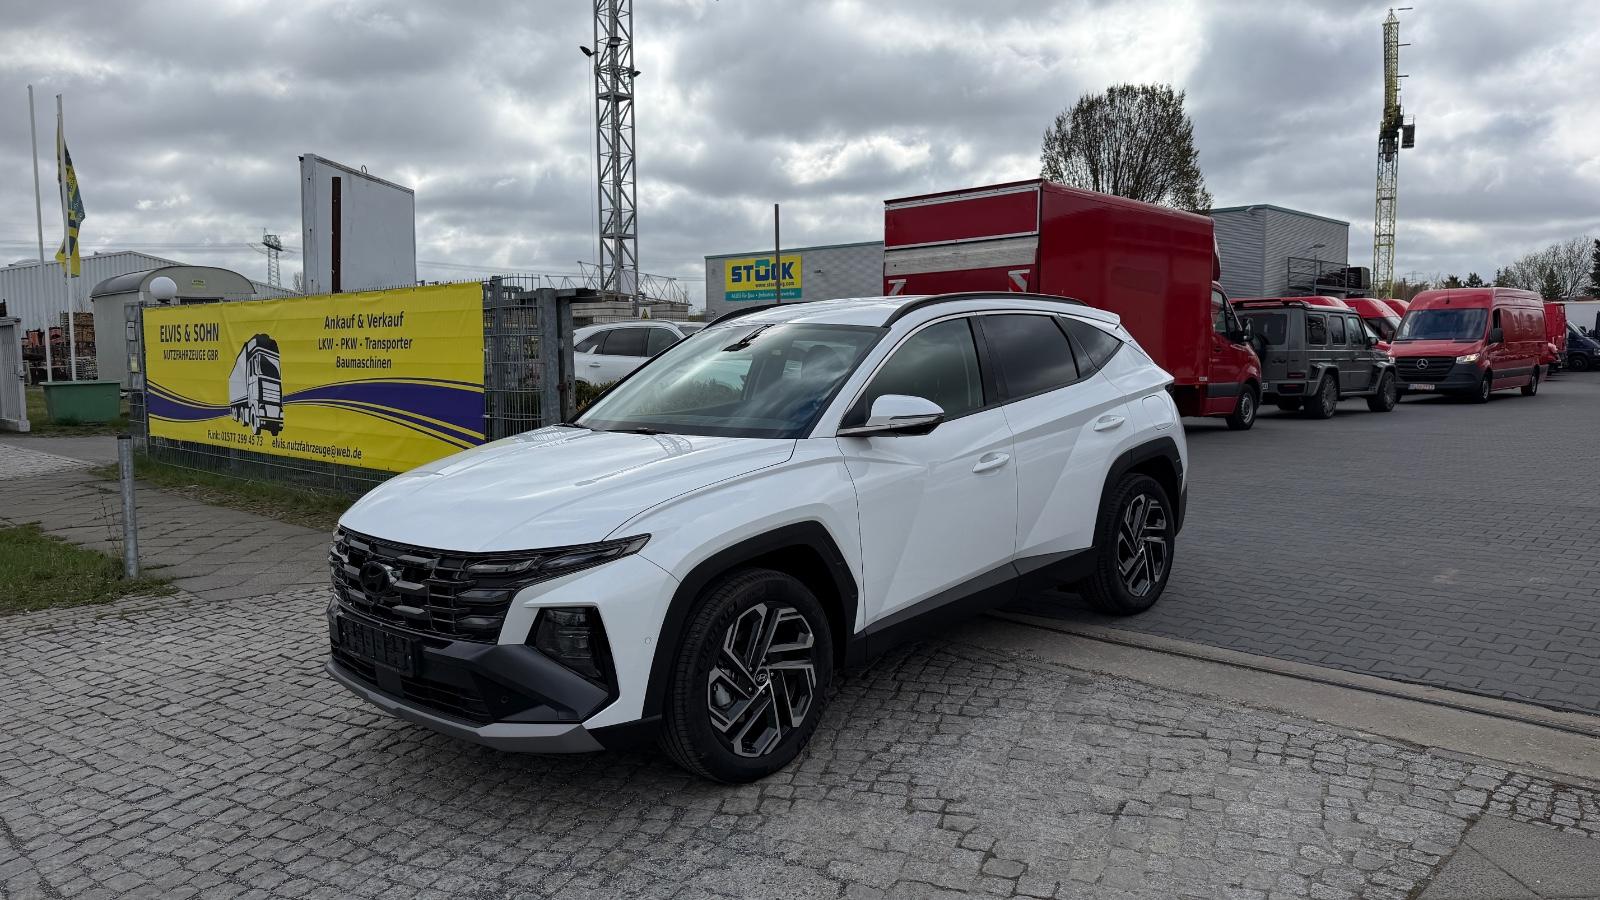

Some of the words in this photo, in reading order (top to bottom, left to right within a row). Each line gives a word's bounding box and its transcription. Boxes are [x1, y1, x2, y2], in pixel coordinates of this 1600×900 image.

[324, 314, 355, 330] Ankauf
[357, 313, 364, 329] &
[367, 310, 405, 329] Verkauf
[160, 324, 181, 342] ELVIS
[185, 323, 190, 342] &
[193, 322, 219, 342] SOHN
[318, 338, 334, 350] LKW
[340, 337, 358, 350] PKW
[364, 336, 413, 352] Transporter
[207, 349, 219, 361] GBR
[336, 355, 392, 369] Baumaschinen
[256, 435, 264, 447] 73
[271, 437, 362, 459] elvis.nutzfahrzeuge@web.de
